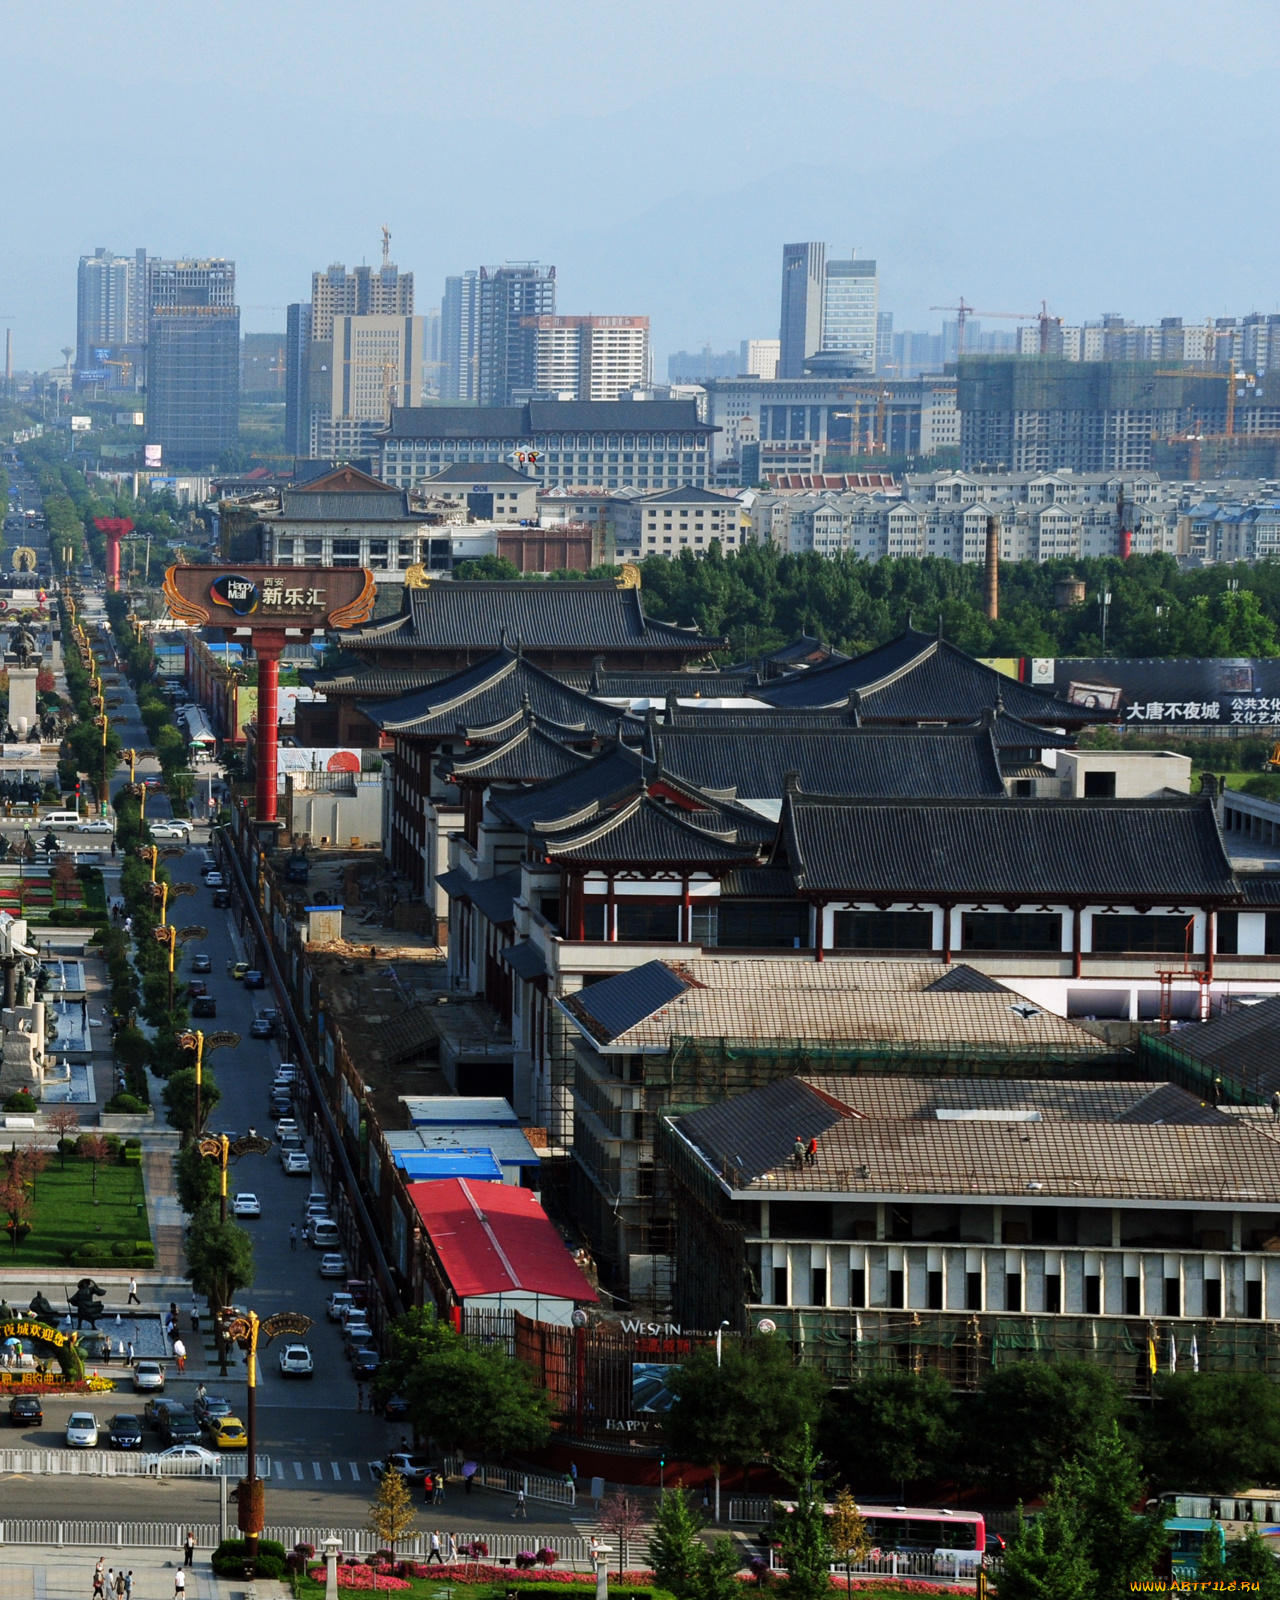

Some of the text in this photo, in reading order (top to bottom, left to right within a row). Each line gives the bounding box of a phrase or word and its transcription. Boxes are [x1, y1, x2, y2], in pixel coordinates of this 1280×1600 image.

[227, 580, 255, 593] Happy
[263, 578, 285, 587] 西安
[227, 589, 247, 600] Mall
[262, 587, 326, 605] 新乐汇
[1126, 701, 1221, 720] 大唐不夜城
[620, 1320, 681, 1336] WESTIN
[714, 1330, 742, 1338] RSORTS
[606, 1418, 650, 1432] HAPPY
